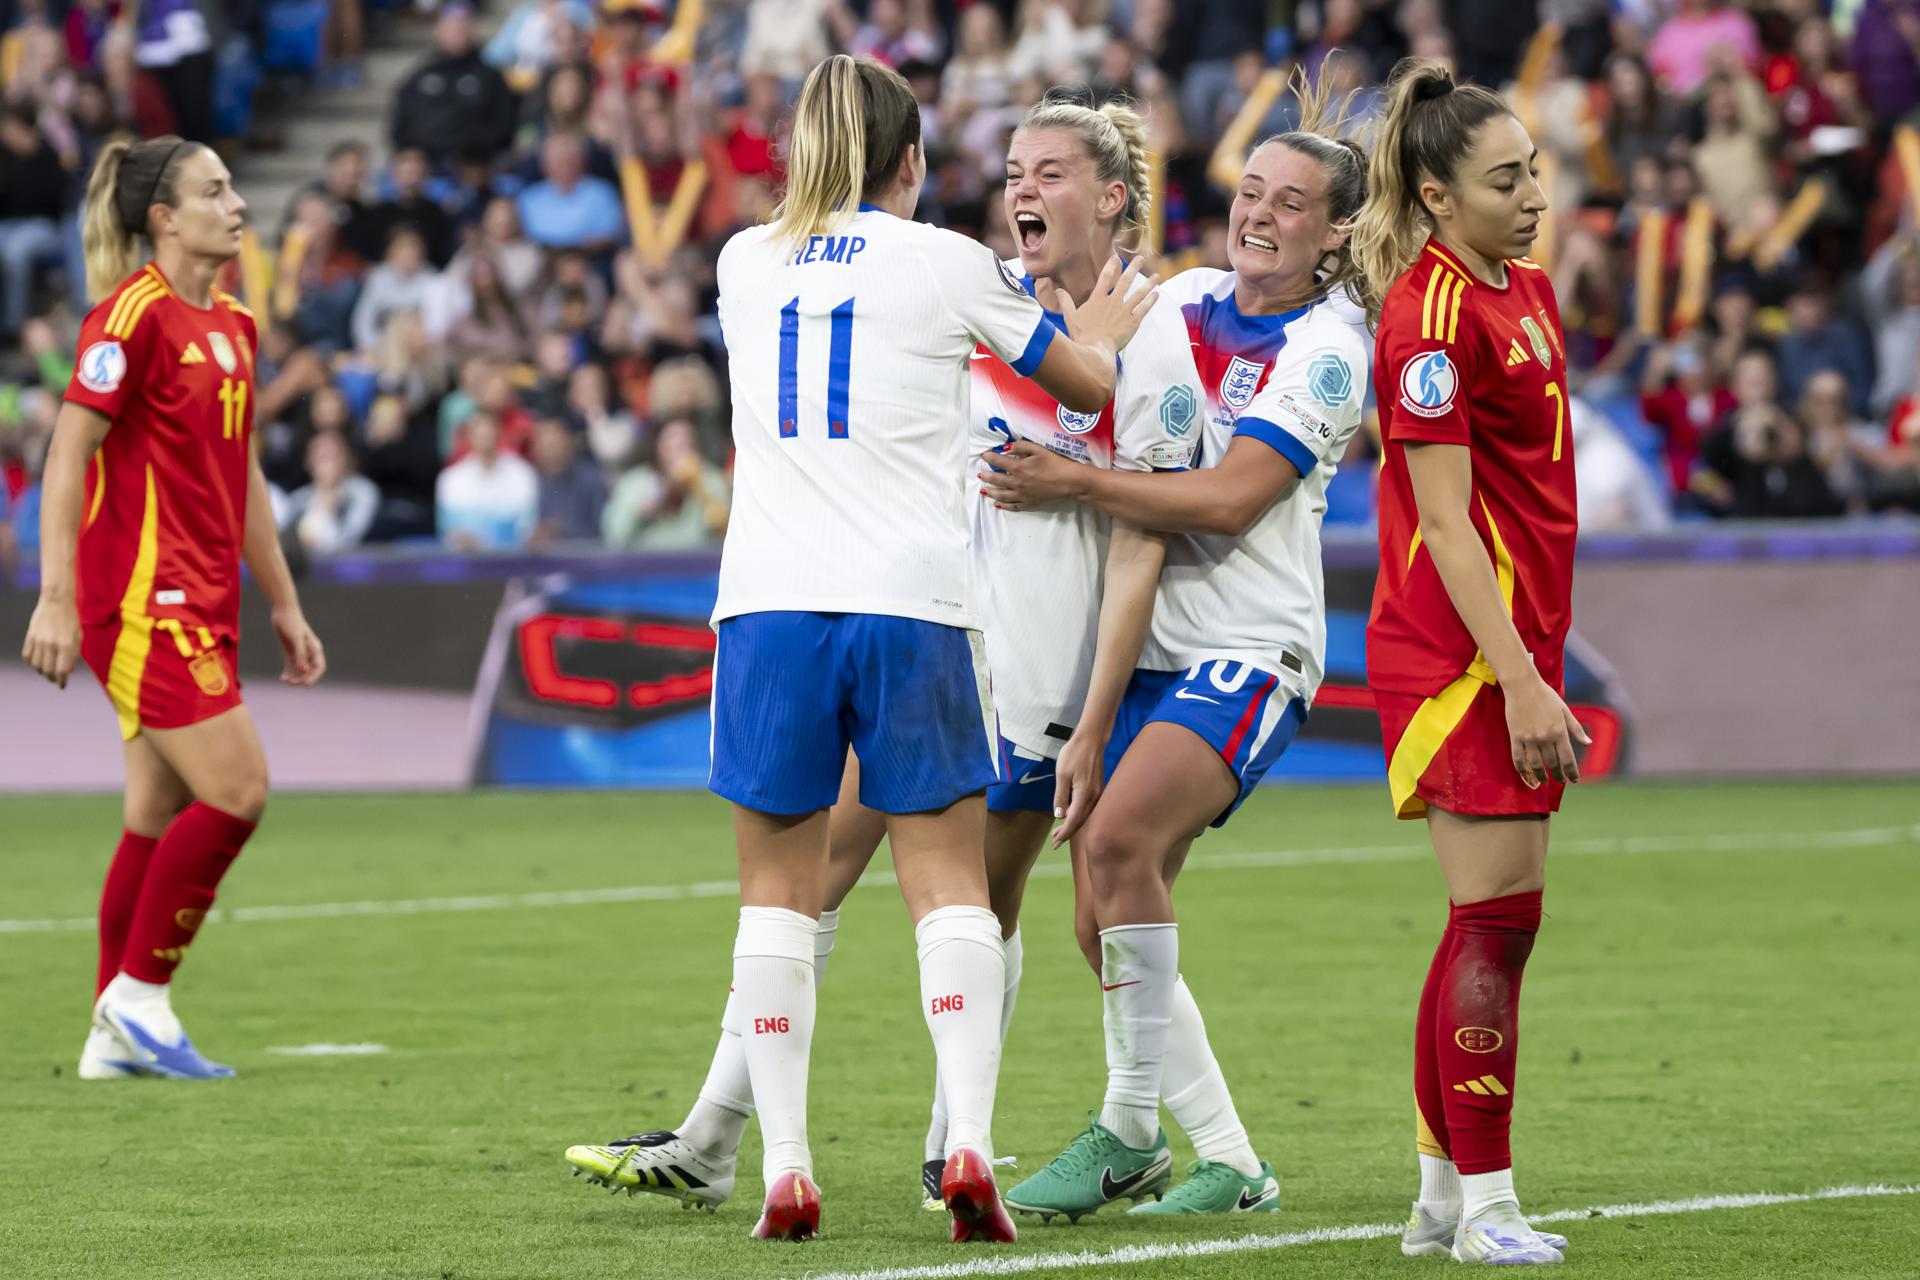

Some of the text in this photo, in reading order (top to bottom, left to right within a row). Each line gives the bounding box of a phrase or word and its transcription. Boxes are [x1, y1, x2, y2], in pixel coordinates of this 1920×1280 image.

[778, 295, 856, 440] 11
[218, 377, 248, 441] 11
[1403, 398, 1452, 416] SWITZERLAND 2025
[1545, 382, 1564, 462] 7
[754, 1017, 790, 1035] ENG
[931, 994, 964, 1016] ENG
